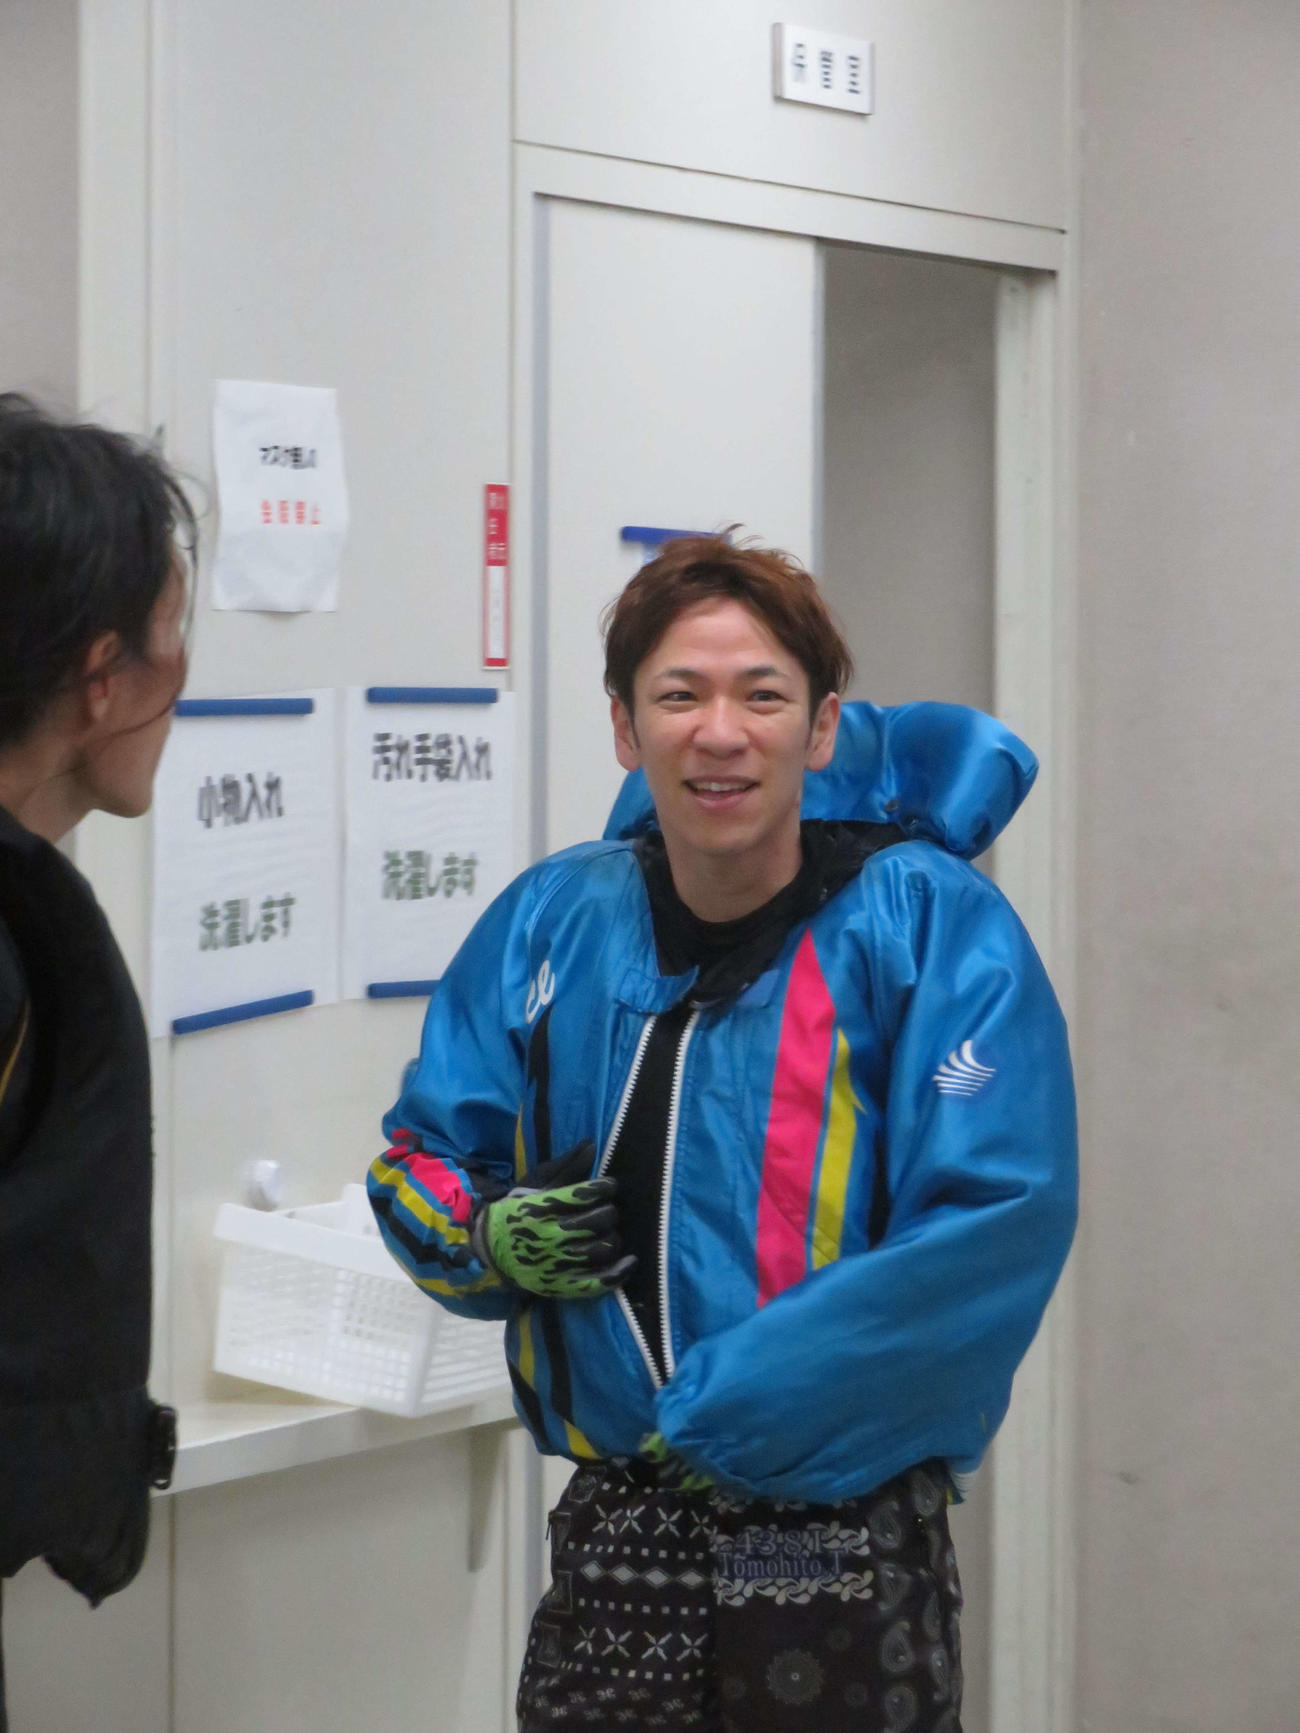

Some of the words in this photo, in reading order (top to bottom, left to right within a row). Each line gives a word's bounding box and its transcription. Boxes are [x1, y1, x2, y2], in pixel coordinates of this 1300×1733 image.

[372, 732, 493, 783] 汚れ手袋入れ
[198, 771, 285, 829] 小物入れ
[382, 850, 479, 901] 洗濯します
[200, 891, 297, 952] 洗濯します
